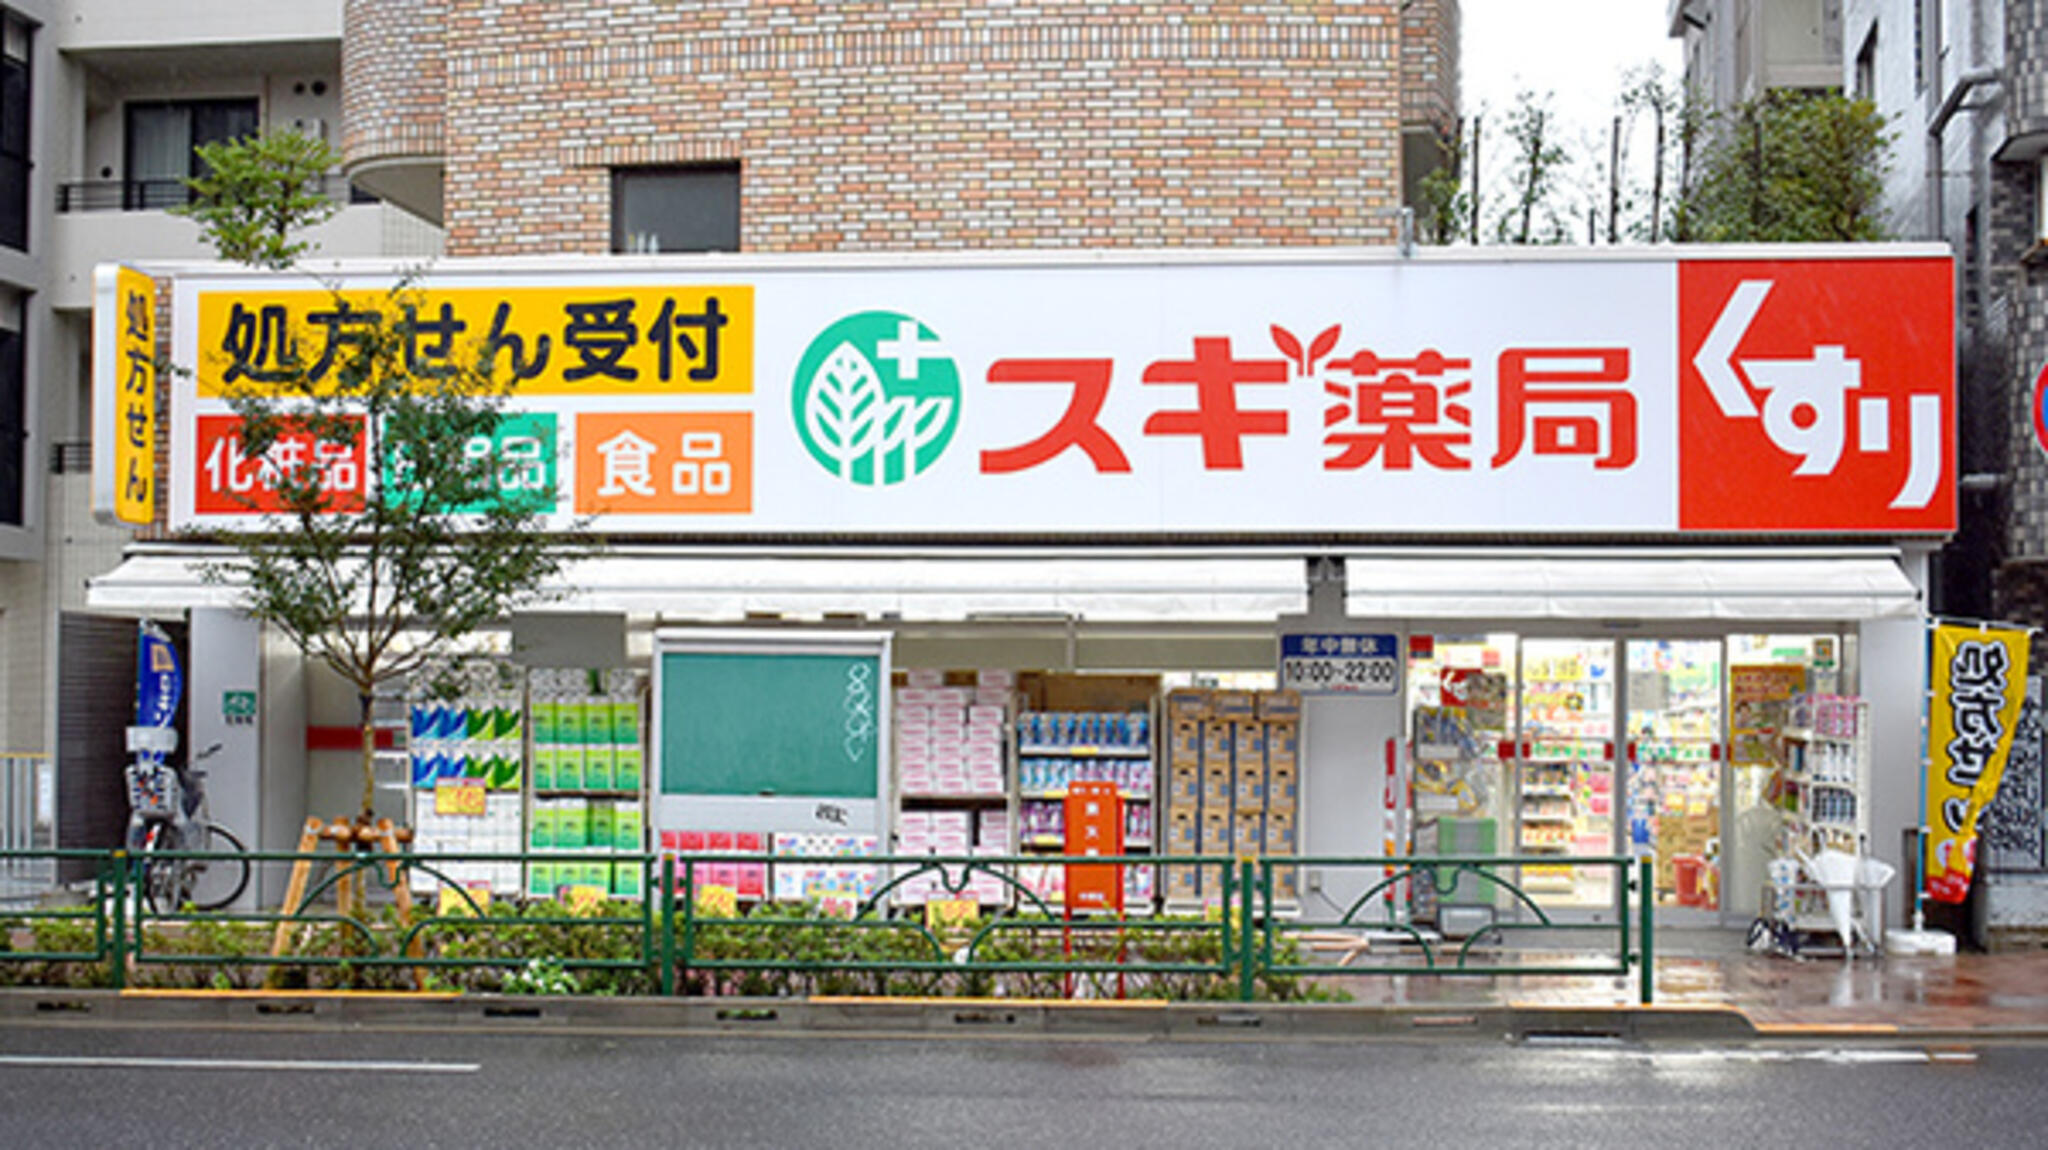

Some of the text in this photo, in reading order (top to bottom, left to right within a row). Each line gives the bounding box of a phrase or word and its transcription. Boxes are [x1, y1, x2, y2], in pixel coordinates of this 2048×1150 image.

[126, 290, 148, 503] 処方せん
[222, 297, 728, 386] 処方せん受付
[979, 324, 1638, 474] スギ薬局
[1692, 279, 1941, 508] くすり
[597, 431, 731, 496] 食品
